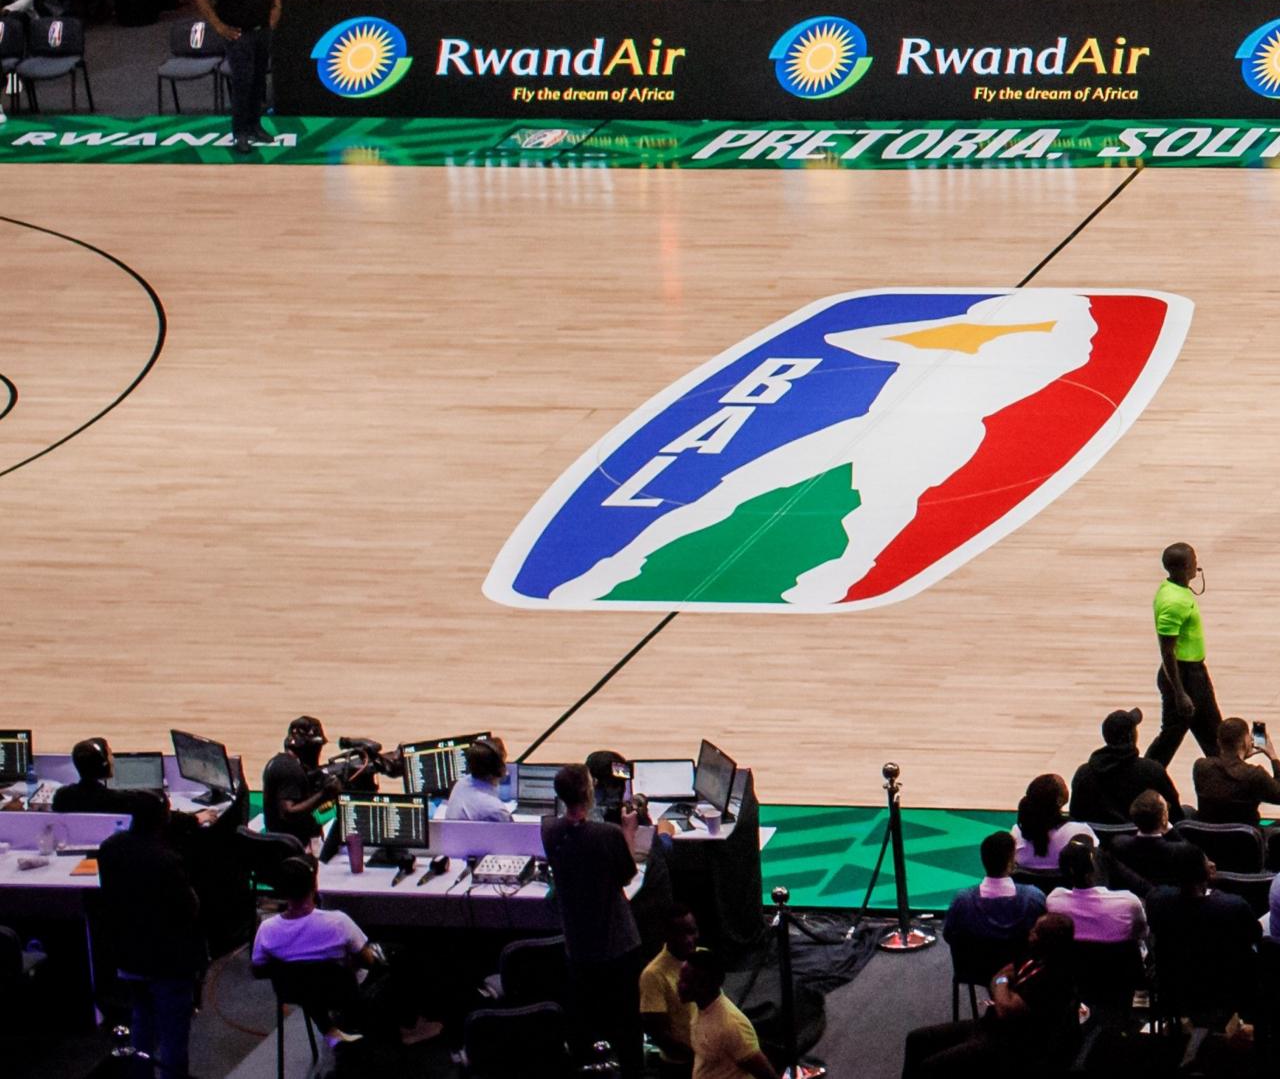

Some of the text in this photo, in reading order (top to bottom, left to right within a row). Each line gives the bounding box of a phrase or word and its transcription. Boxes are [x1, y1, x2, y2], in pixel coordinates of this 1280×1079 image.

[436, 37, 686, 76] RwandAir
[897, 36, 1150, 75] RwandAir
[513, 86, 675, 102] Fly the dream of Africa
[973, 86, 1139, 102] Fly the dream of Africa
[602, 357, 824, 508] BAL
